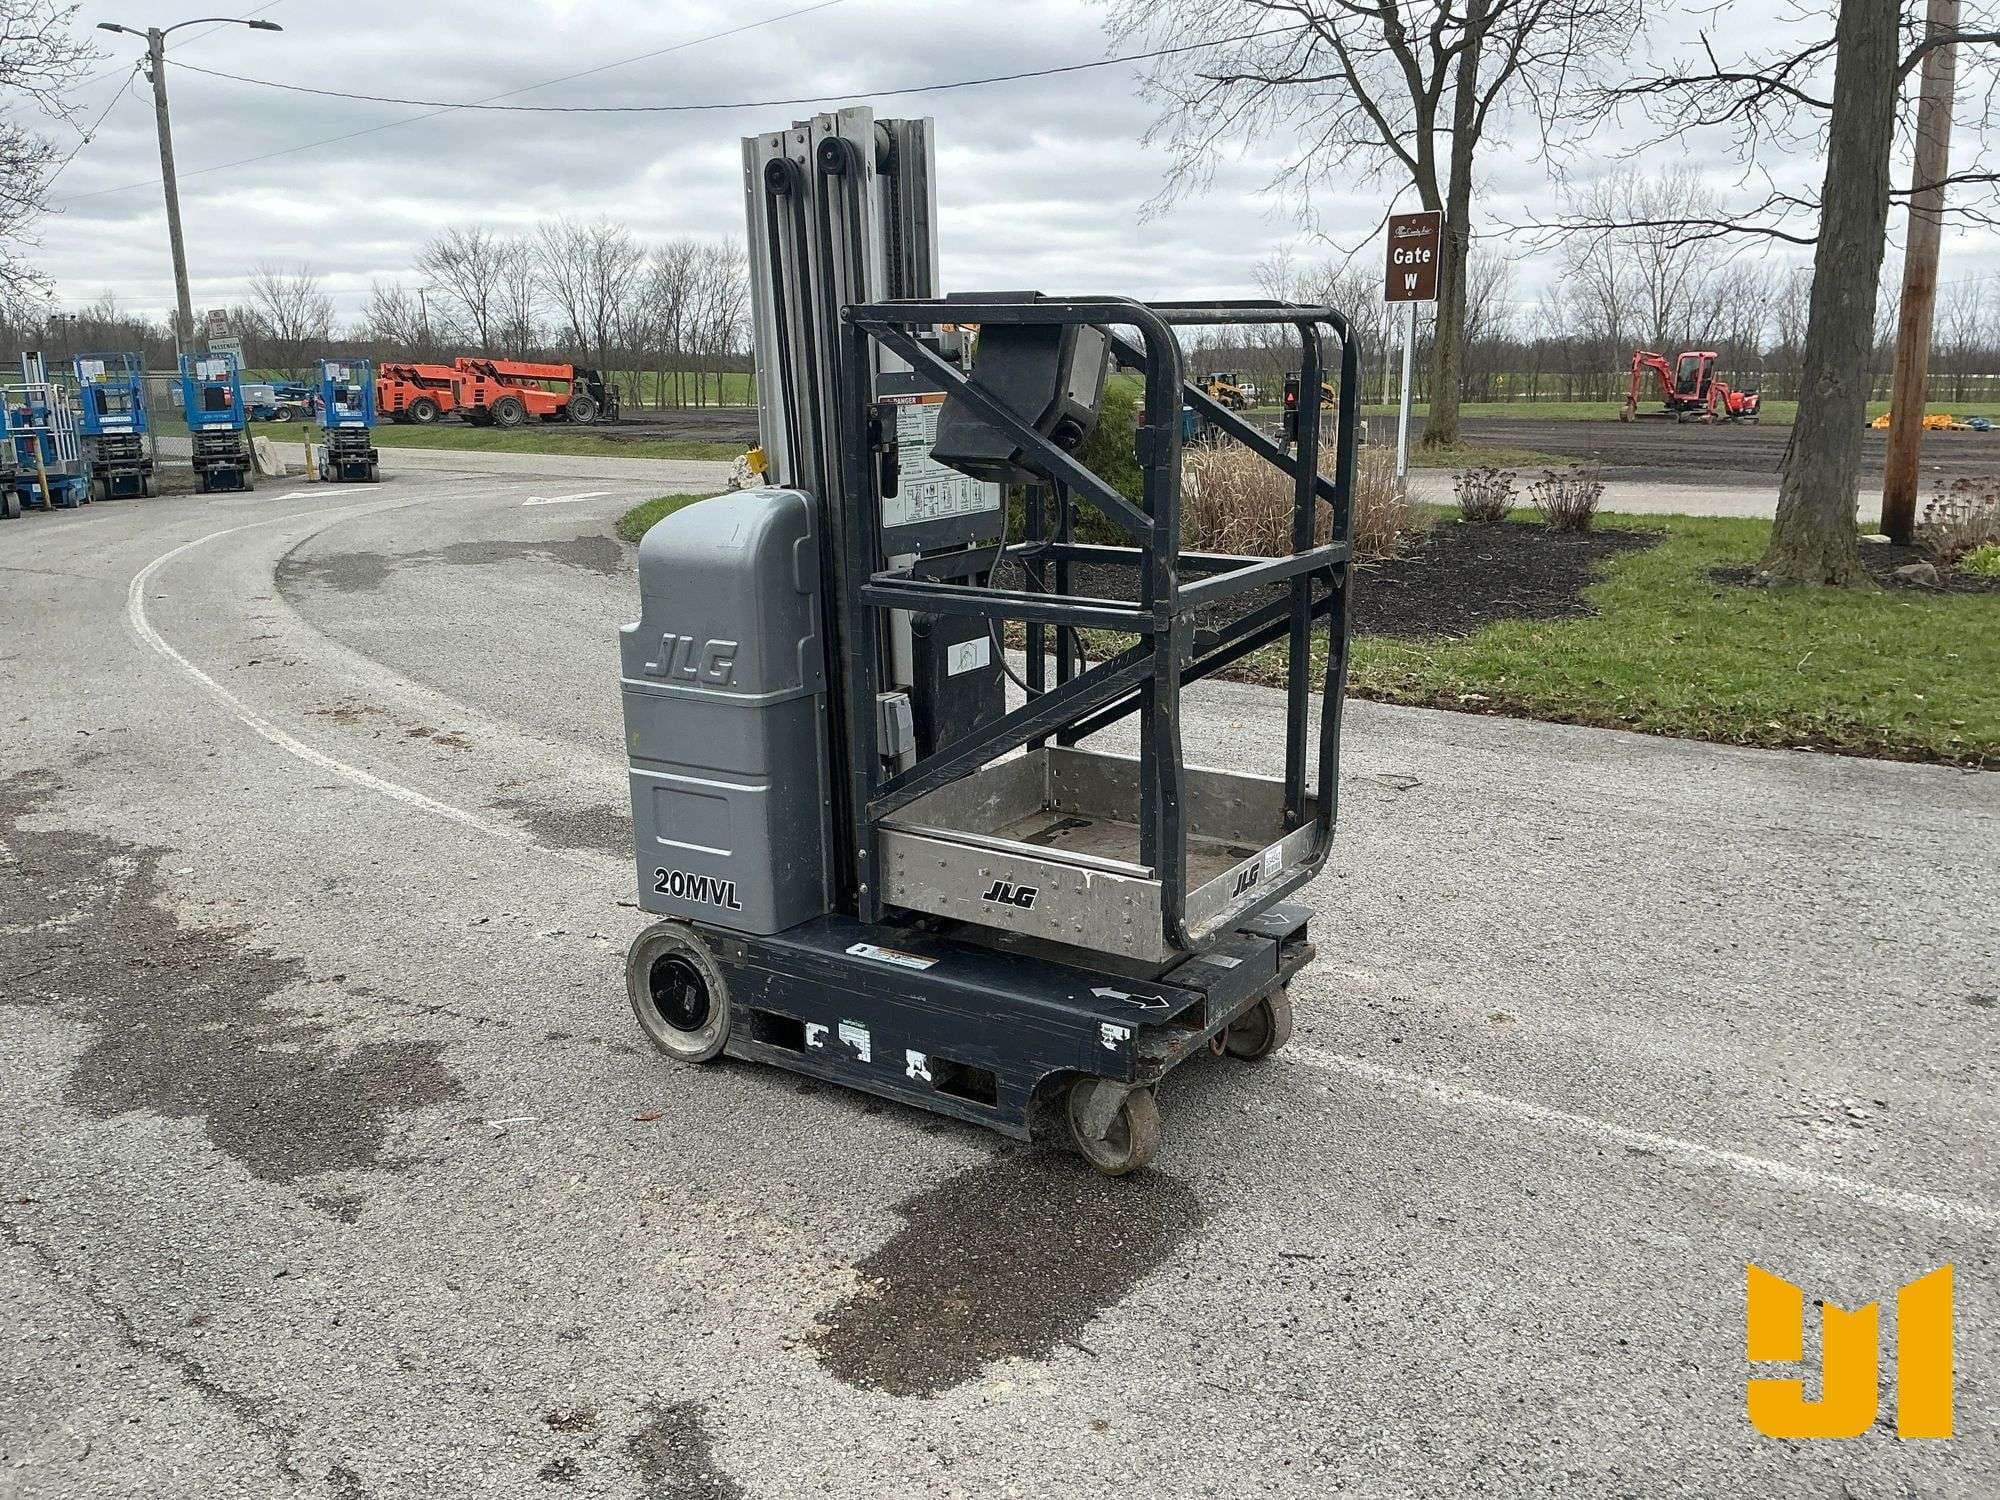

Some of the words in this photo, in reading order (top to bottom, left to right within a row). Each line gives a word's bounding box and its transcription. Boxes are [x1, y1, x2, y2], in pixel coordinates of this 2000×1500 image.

[1393, 246, 1431, 265] Gate
[1404, 272, 1418, 290] W
[893, 396, 917, 405] DANGER
[644, 632, 738, 686] JLG
[653, 866, 743, 912] 20MVL
[981, 879, 1039, 911] JLG
[1231, 860, 1260, 898] JLG
